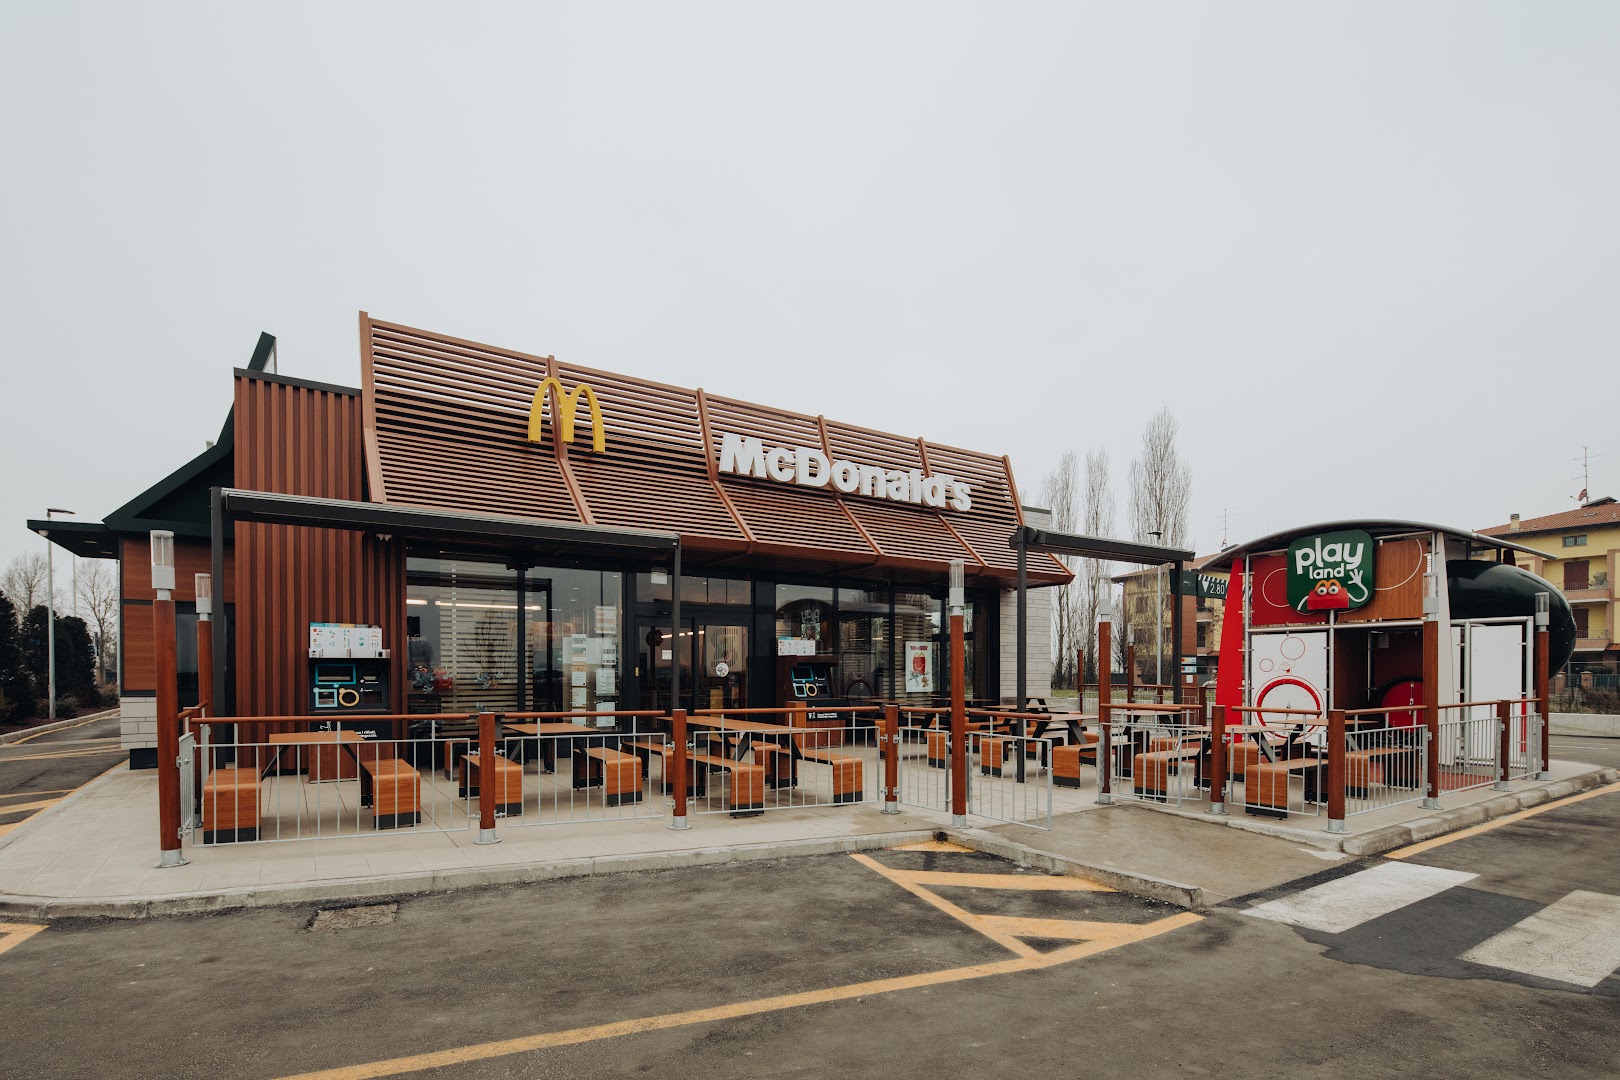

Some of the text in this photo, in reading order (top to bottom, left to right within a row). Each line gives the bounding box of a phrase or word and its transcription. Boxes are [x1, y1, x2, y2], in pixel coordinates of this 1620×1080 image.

[527, 377, 605, 455] M
[719, 433, 972, 512] McDonald's
[1295, 537, 1364, 575] play
[1309, 563, 1345, 580] land
[1210, 583, 1225, 595] 2.80
